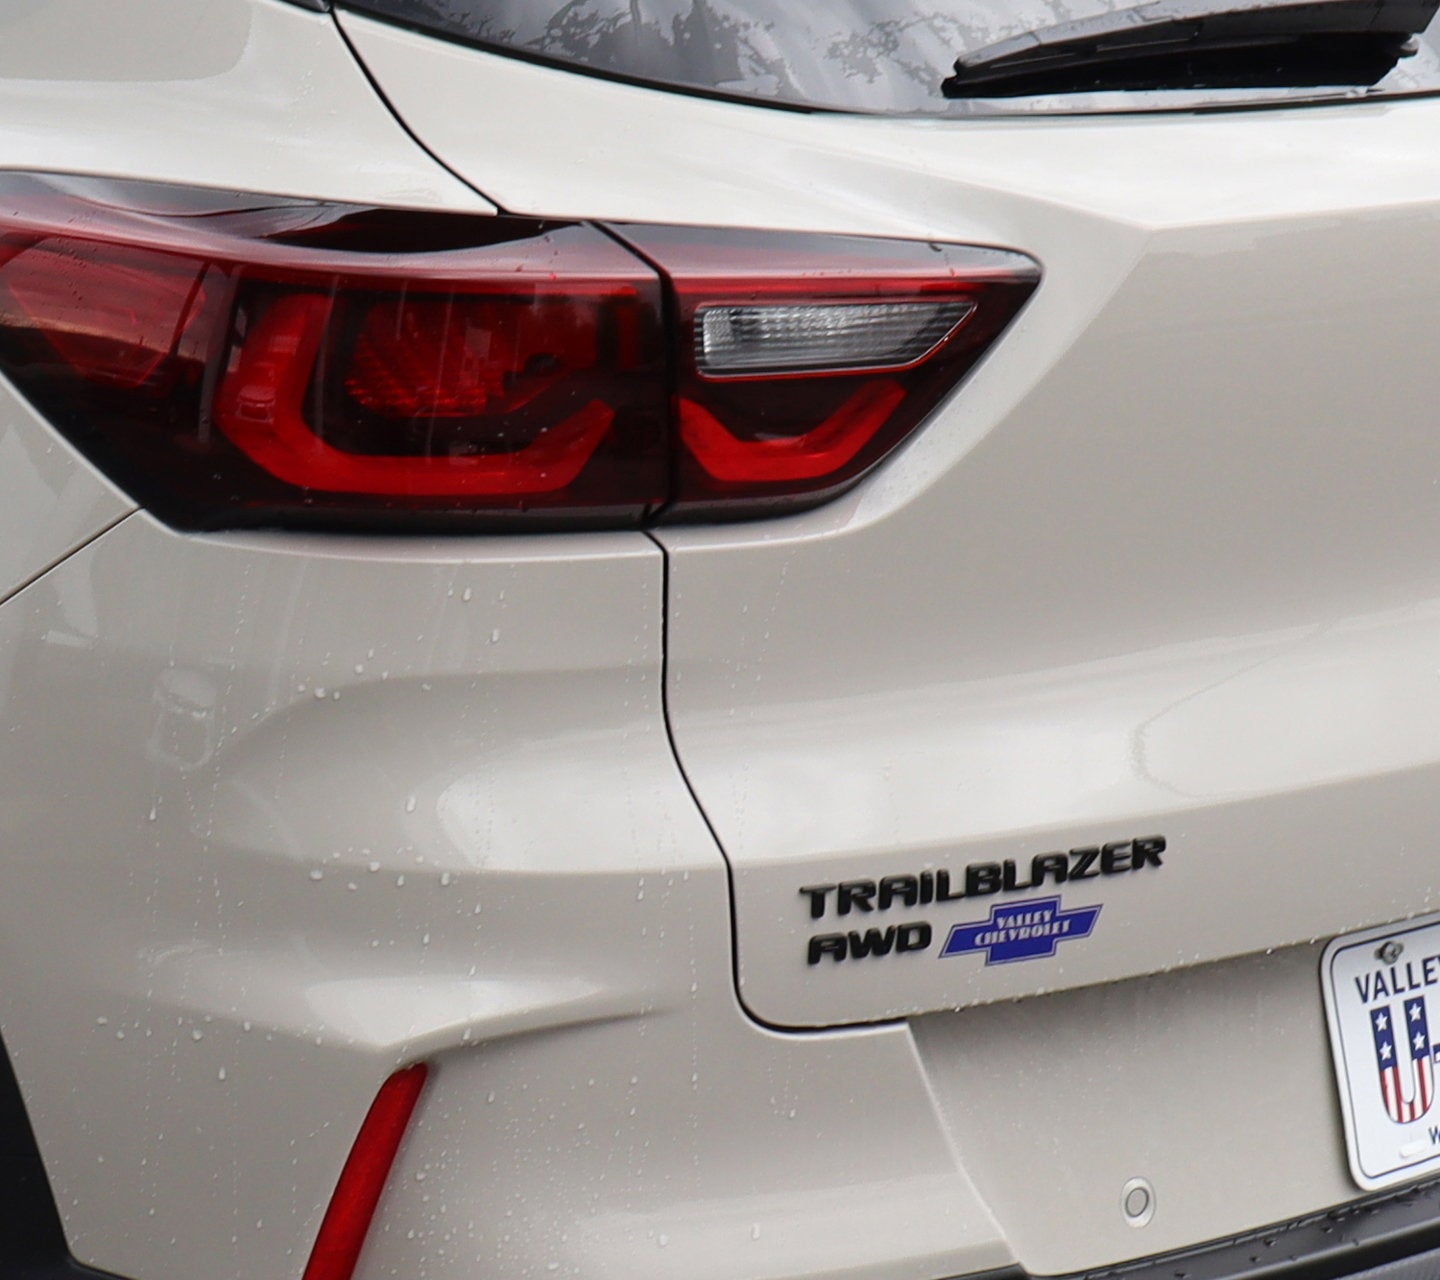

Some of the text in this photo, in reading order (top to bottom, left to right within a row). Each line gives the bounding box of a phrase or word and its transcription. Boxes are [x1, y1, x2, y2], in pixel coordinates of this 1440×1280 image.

[799, 834, 1167, 921] TRAILBLAZER
[974, 919, 1073, 947] CHEVROLET
[996, 908, 1055, 930] VALLEY
[807, 920, 933, 966] AWD
